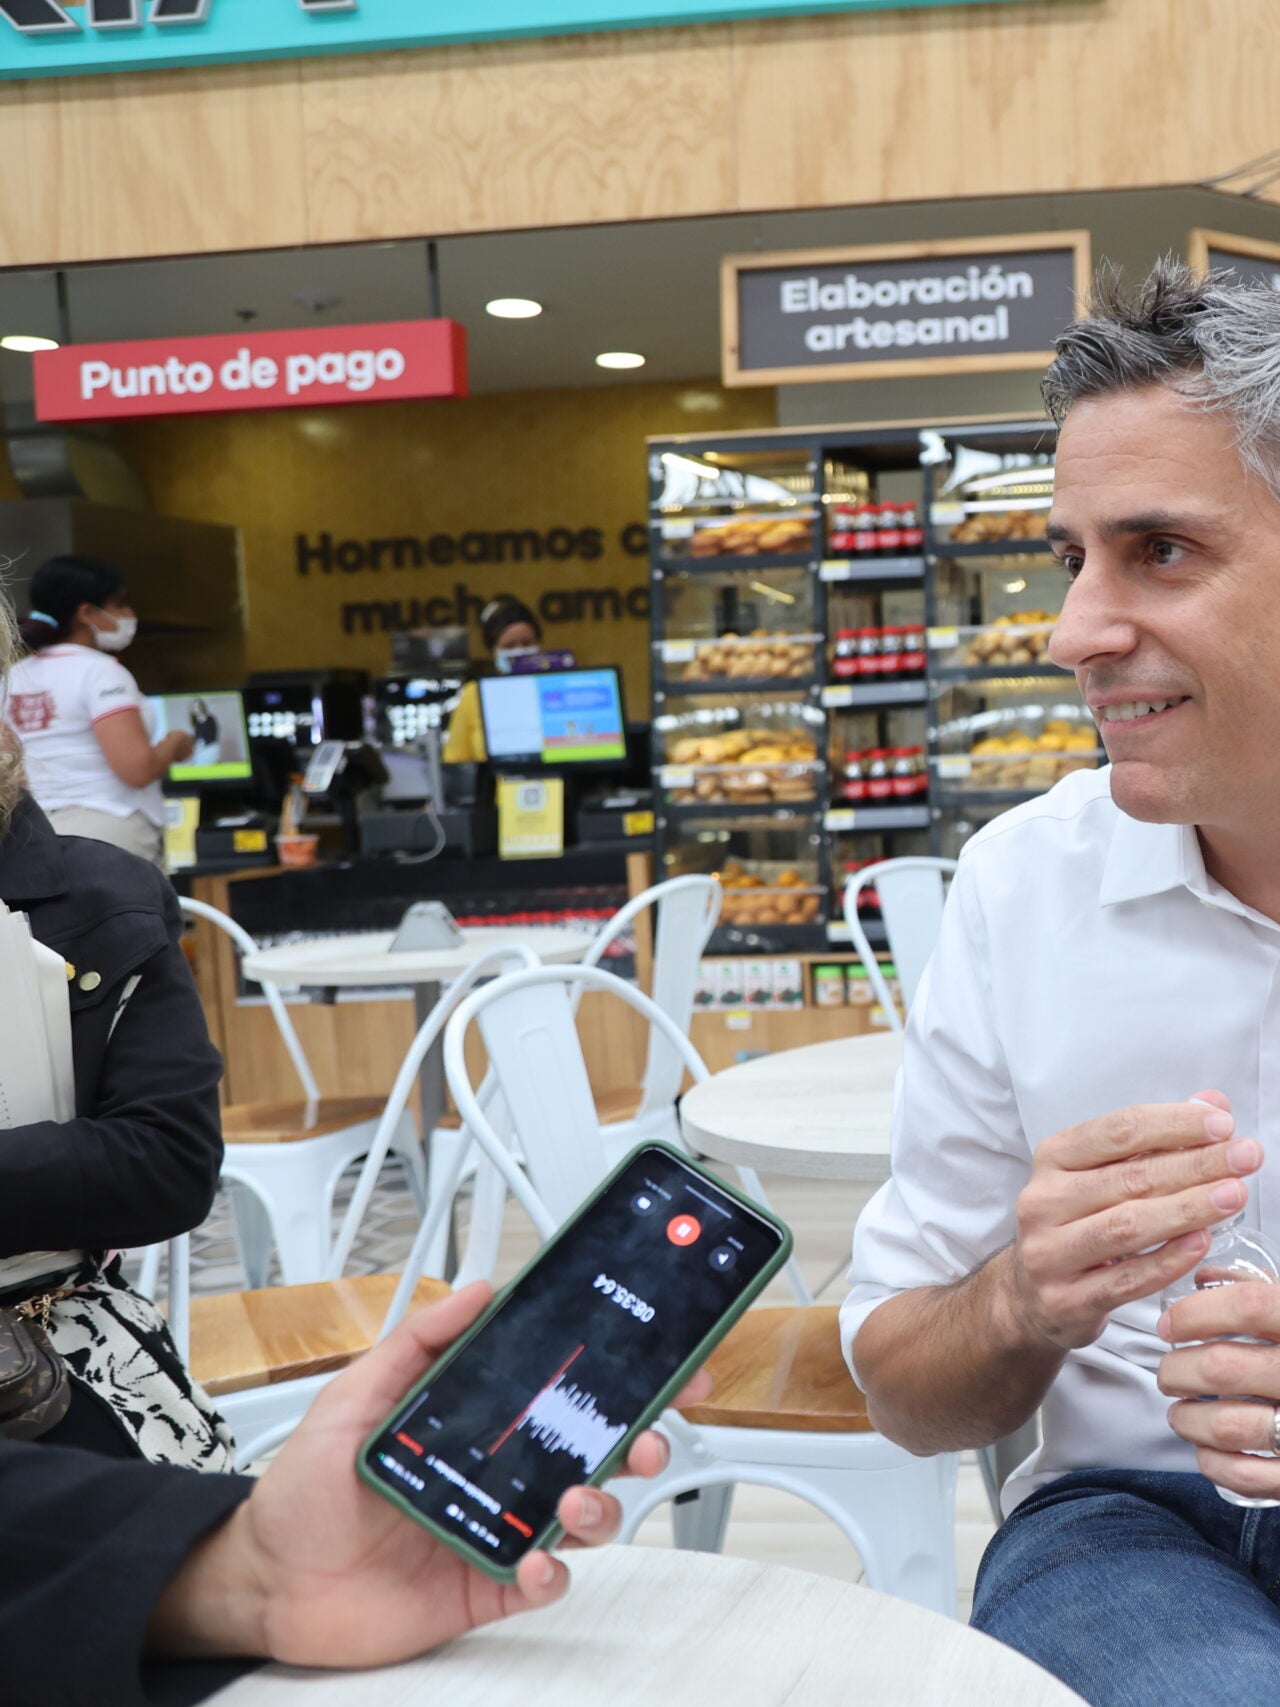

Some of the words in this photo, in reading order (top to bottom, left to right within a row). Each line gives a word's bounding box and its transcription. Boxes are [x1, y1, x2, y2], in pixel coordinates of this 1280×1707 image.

[780, 265, 1033, 313] Elaboración
[805, 307, 1010, 352] artesanal
[81, 356, 213, 400] Punto
[220, 349, 278, 388] de
[286, 347, 405, 396] pago
[296, 525, 605, 576] Horneamos
[342, 582, 518, 634] much
